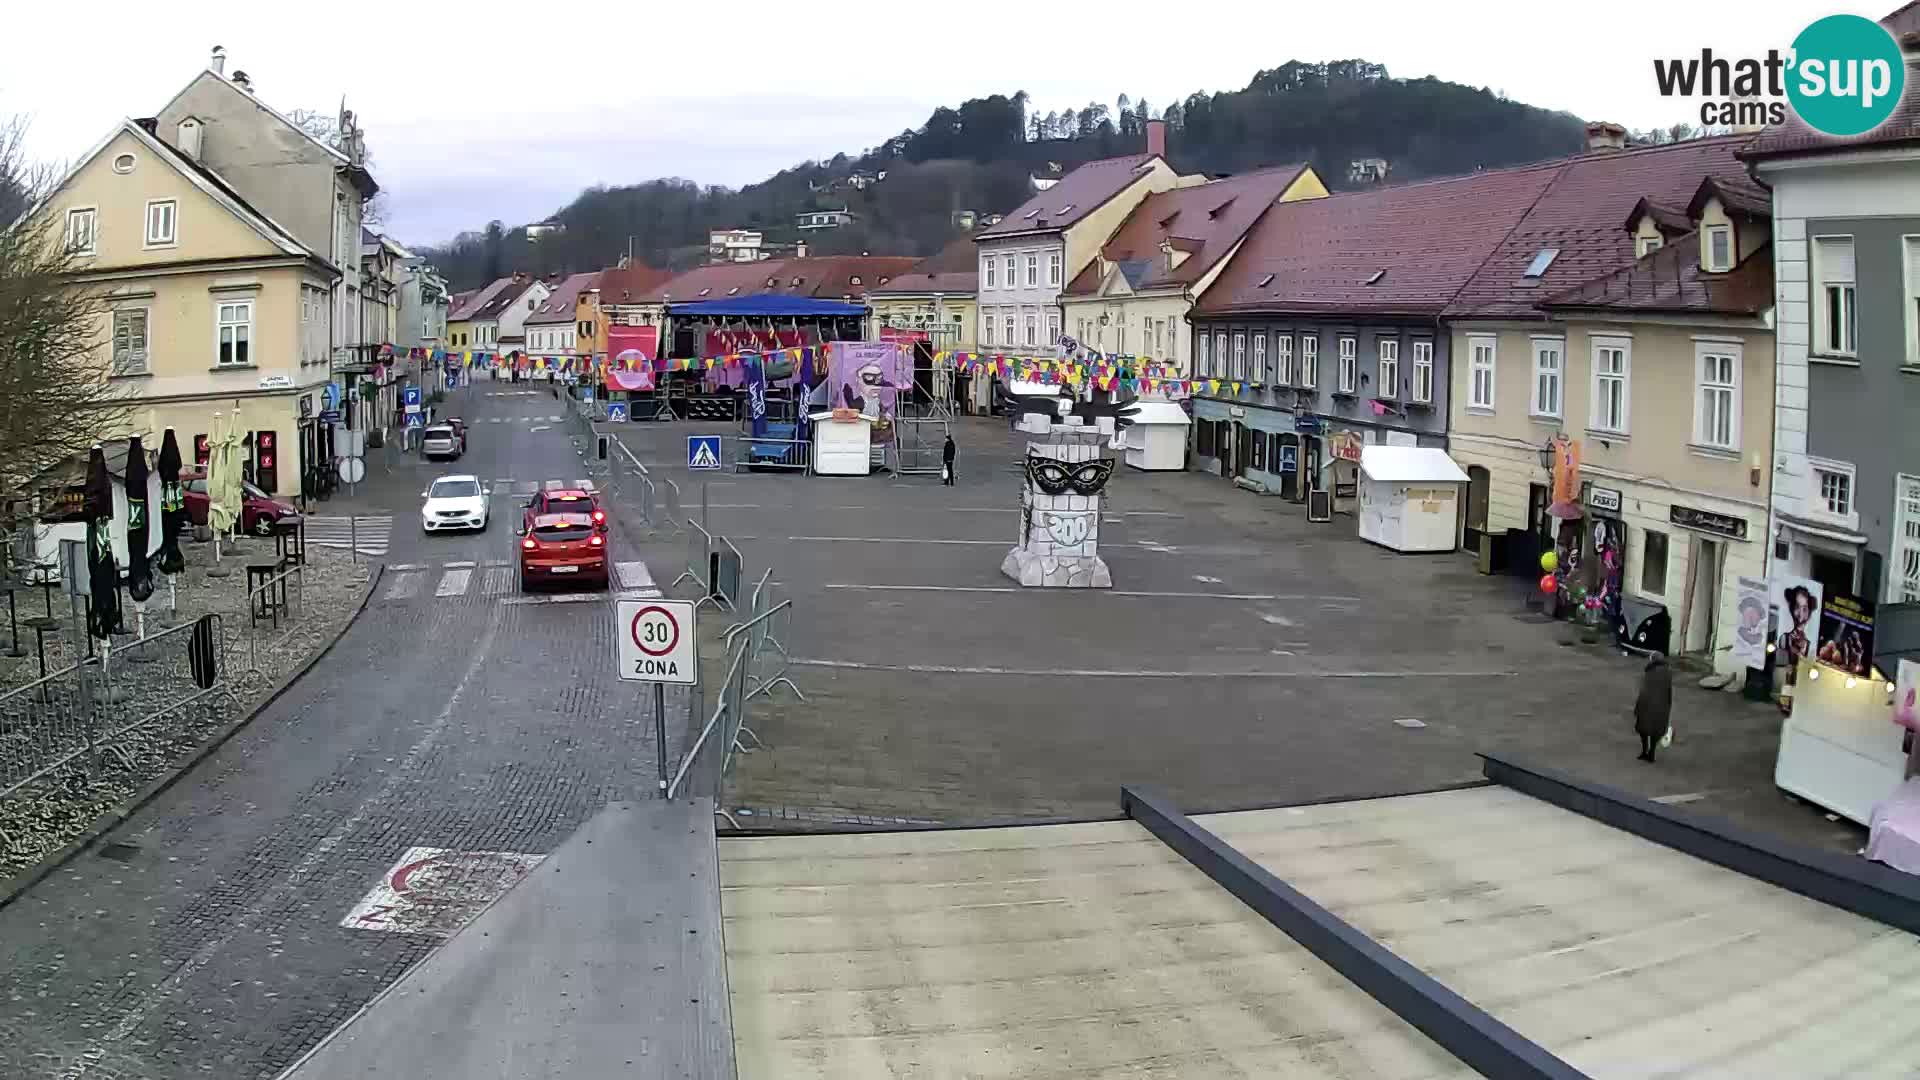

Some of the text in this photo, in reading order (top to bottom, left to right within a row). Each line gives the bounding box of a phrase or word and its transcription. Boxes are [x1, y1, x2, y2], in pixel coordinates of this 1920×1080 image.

[408, 391, 416, 402] P
[644, 622, 668, 642] 30
[634, 659, 678, 676] ZONA
